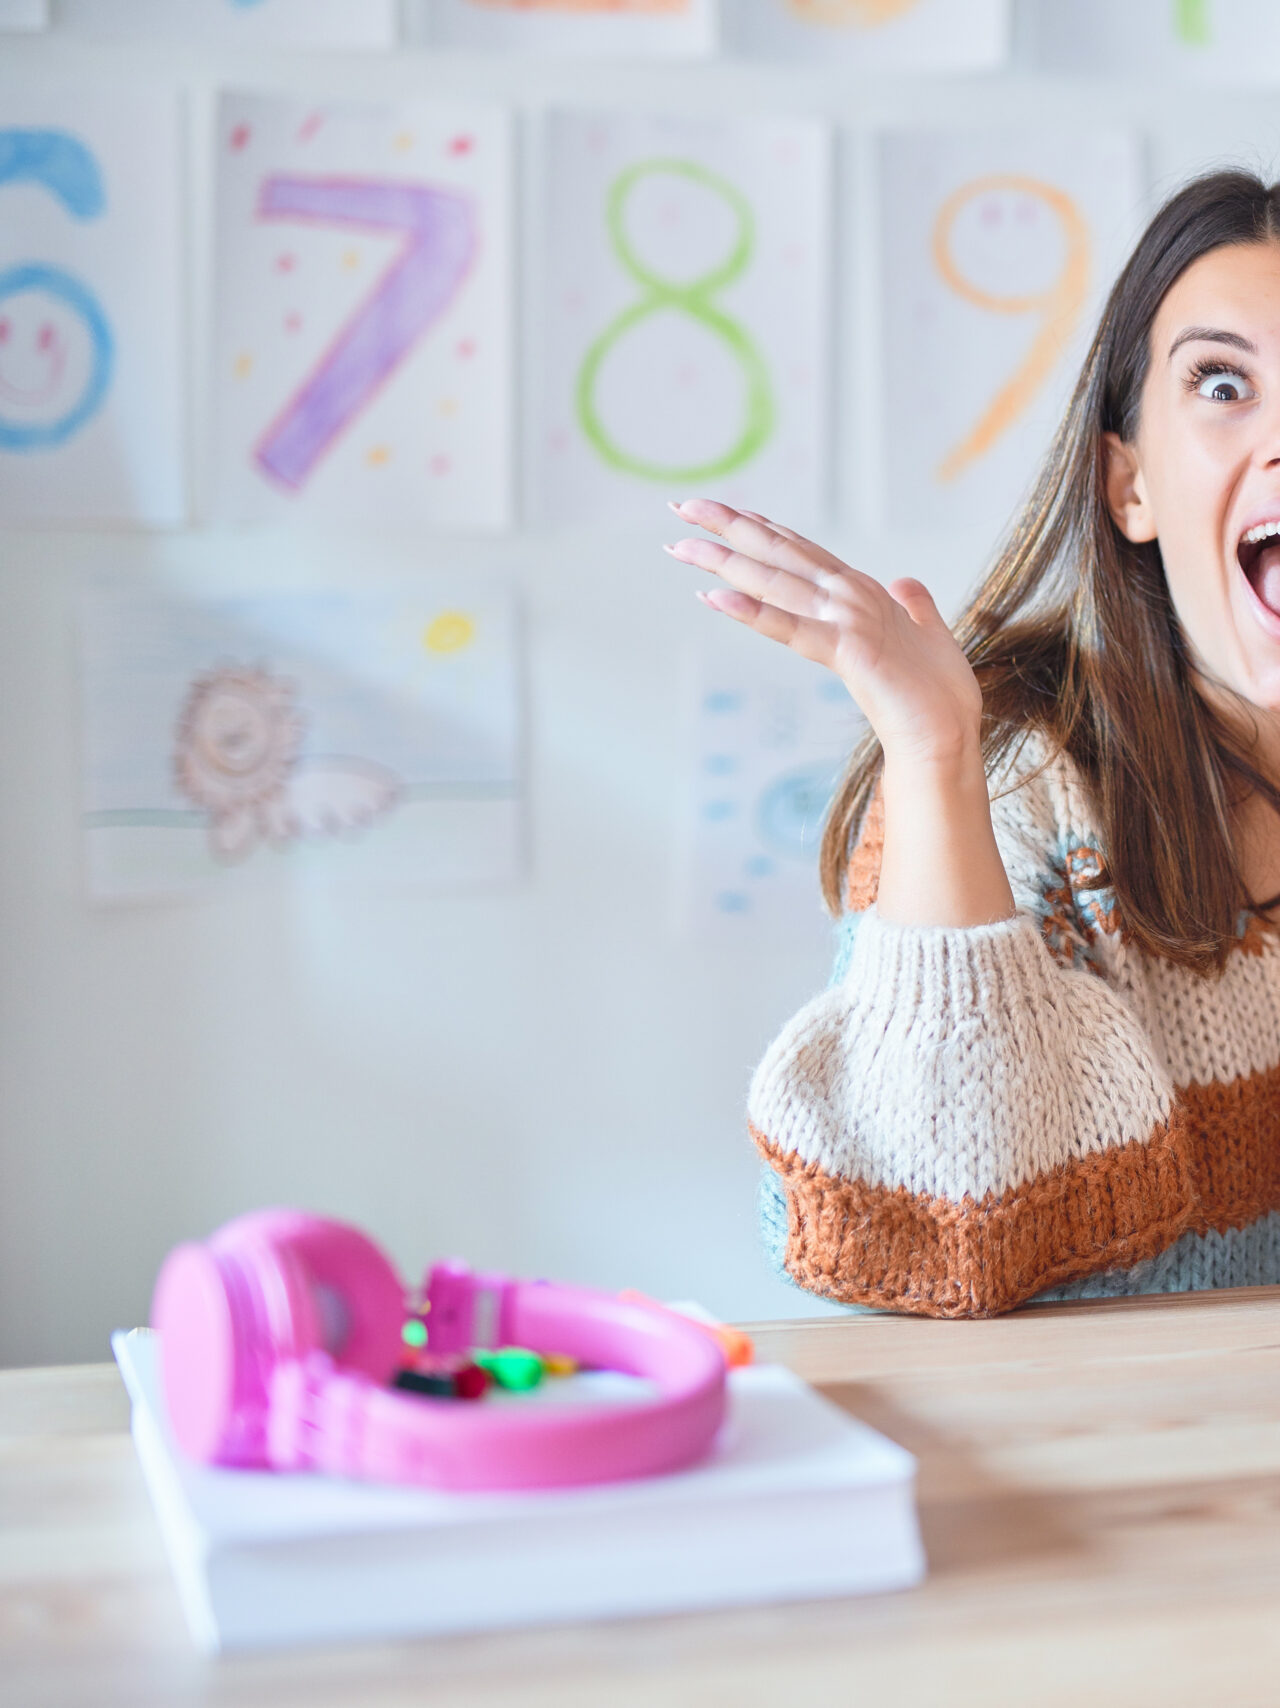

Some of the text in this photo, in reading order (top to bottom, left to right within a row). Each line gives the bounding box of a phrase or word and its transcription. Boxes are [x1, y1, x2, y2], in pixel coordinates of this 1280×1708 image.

[250, 172, 482, 496] 7
[574, 157, 777, 485] 8
[931, 173, 1092, 484] 9
